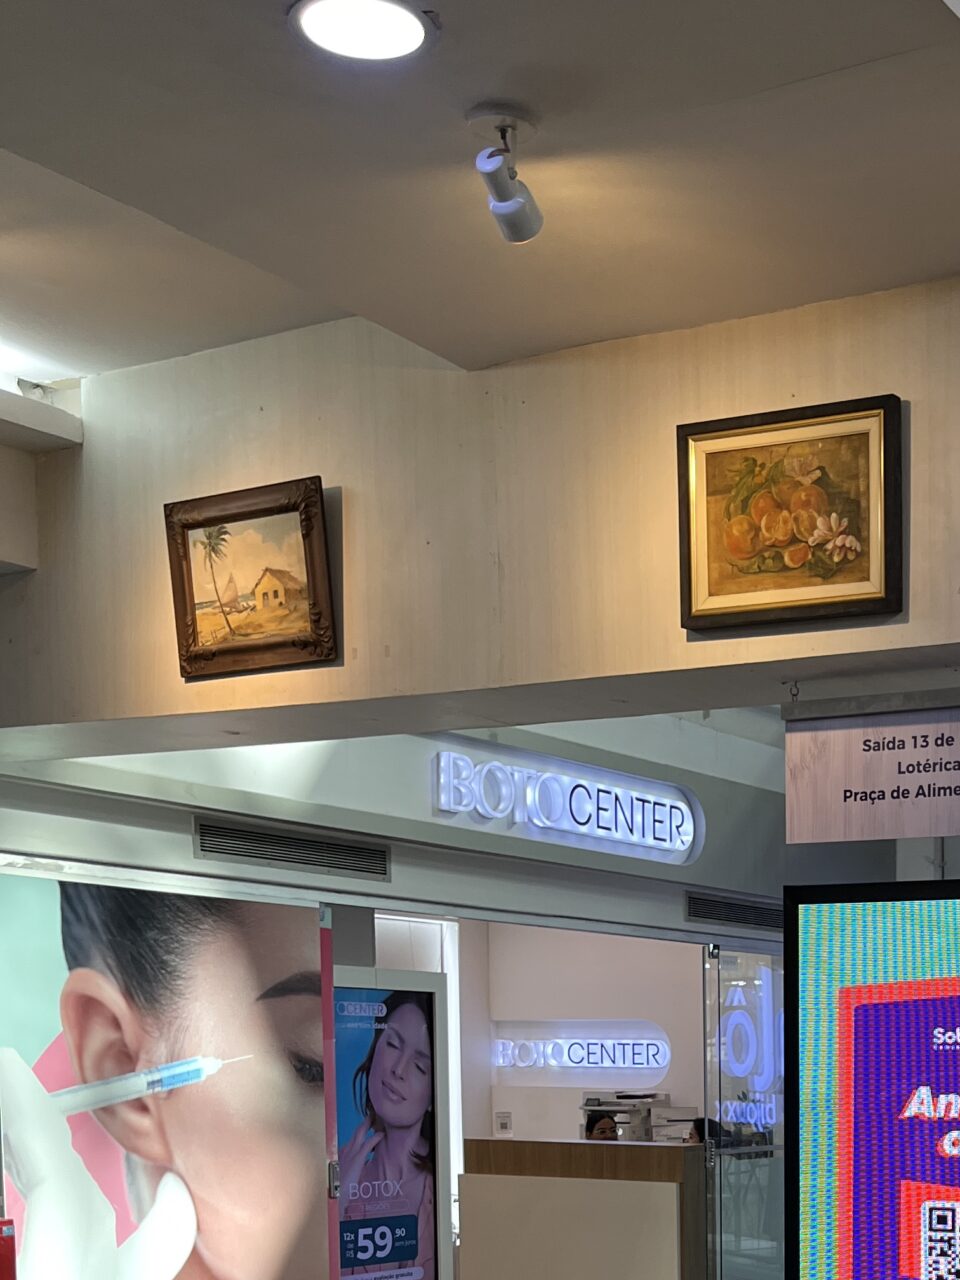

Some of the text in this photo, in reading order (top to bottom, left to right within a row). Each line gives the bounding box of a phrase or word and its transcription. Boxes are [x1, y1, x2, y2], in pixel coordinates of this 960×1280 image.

[862, 736, 906, 752] Saída
[911, 734, 930, 750] 13
[934, 732, 955, 748] de
[843, 789, 886, 805] Praça
[890, 785, 911, 800] de
[349, 1180, 404, 1200] BOTOX
[343, 1232, 355, 1241] 12x
[356, 1225, 393, 1260] 59
